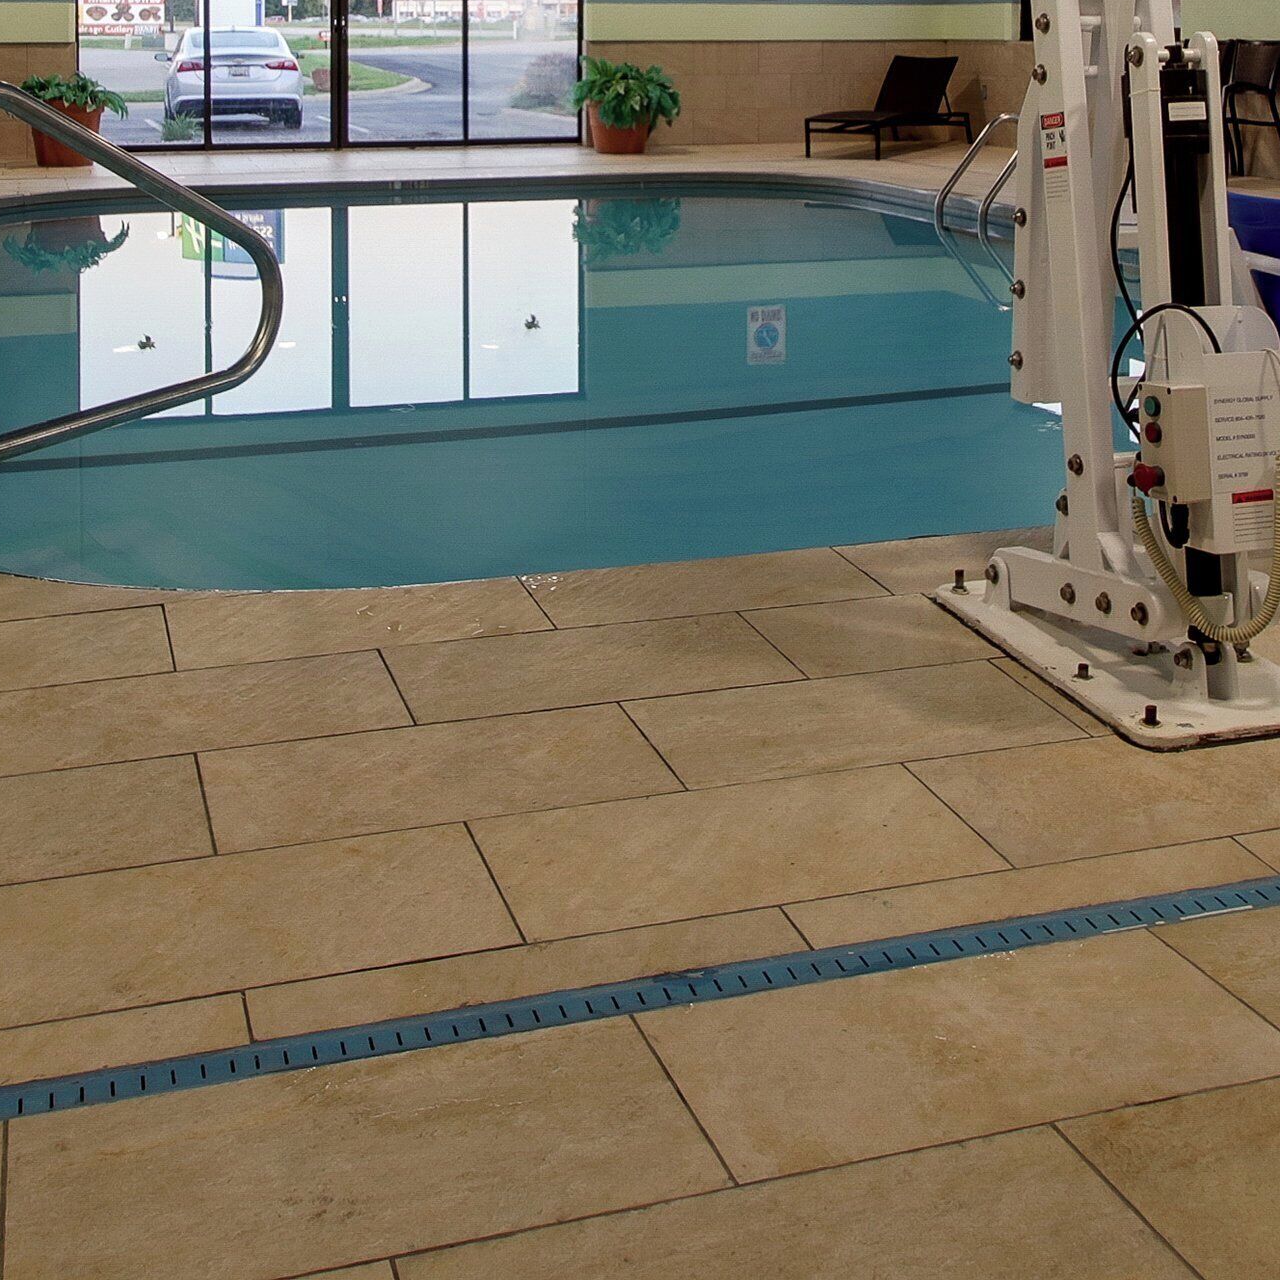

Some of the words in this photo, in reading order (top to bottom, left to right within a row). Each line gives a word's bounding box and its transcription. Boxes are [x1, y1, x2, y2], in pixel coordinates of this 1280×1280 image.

[104, 25, 133, 36] Cutlery
[1255, 394, 1273, 402] SUPPLY
[1217, 452, 1244, 461] ELECTRICAL
